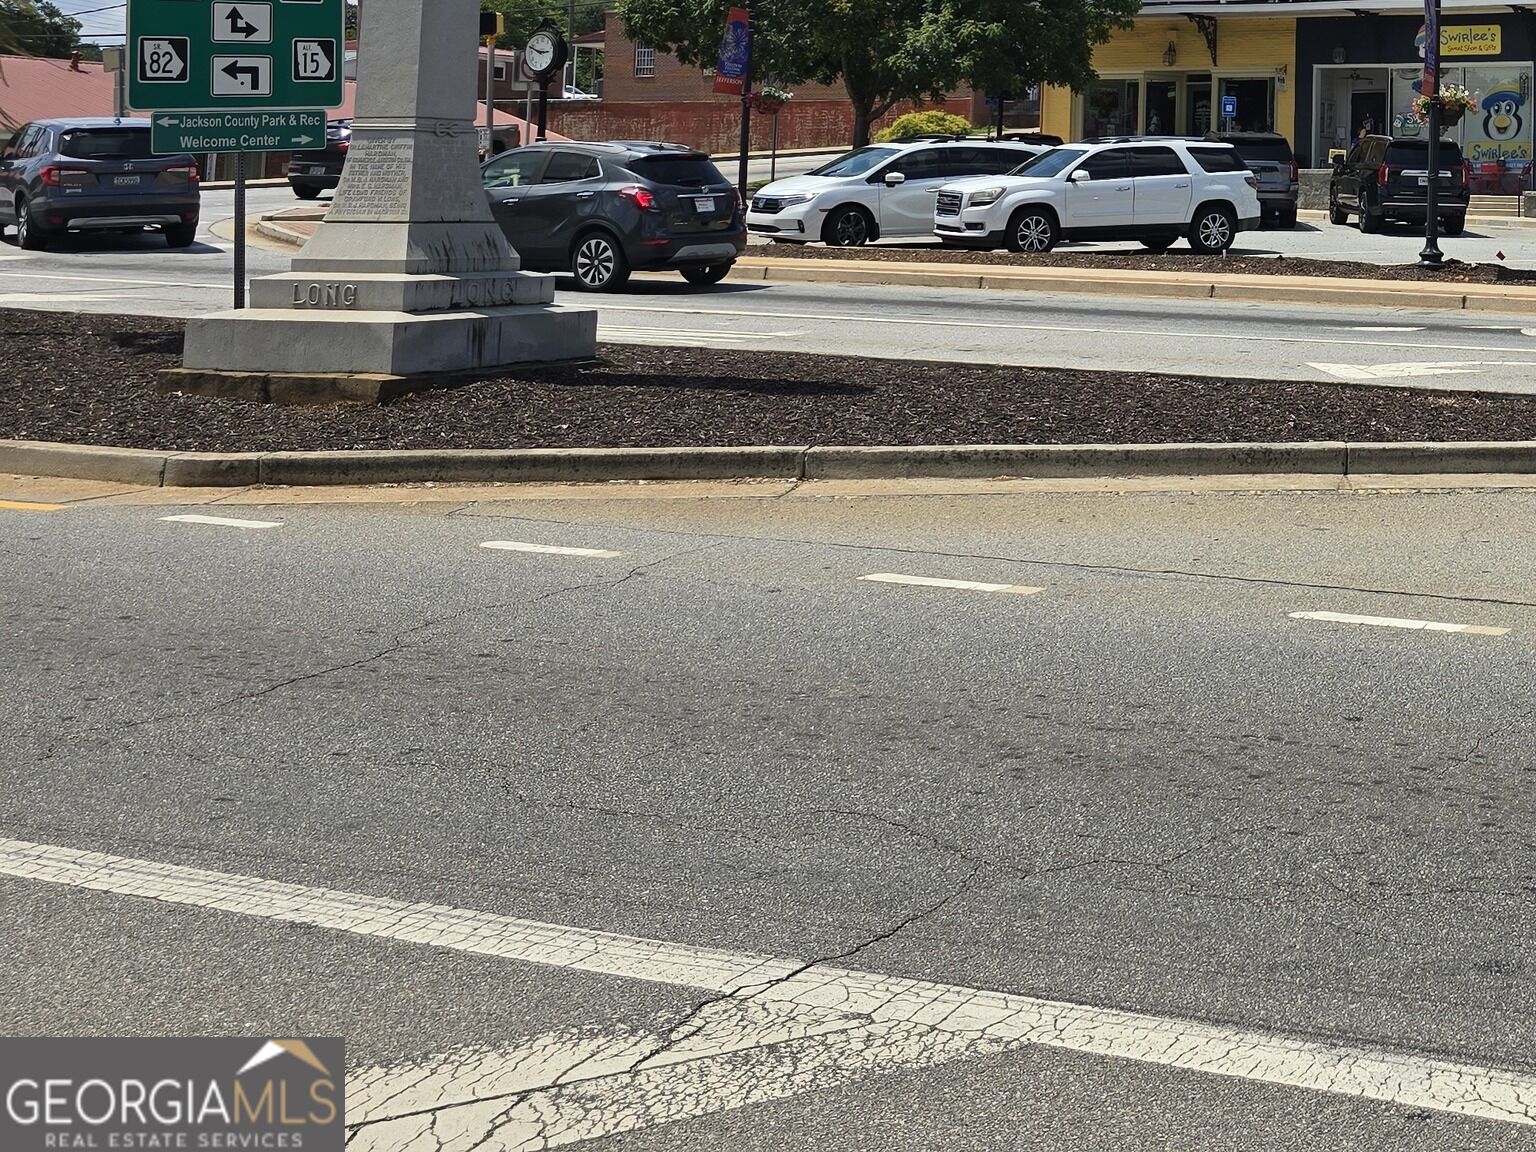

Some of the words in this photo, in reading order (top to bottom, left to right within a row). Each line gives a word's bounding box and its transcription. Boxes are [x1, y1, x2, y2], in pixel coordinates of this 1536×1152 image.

[149, 51, 173, 74] 82
[302, 52, 319, 74] 15
[180, 116, 222, 128] Jackson
[224, 115, 260, 129] County
[262, 115, 286, 126] Park
[289, 115, 297, 126] &
[300, 114, 320, 126] Rec
[180, 135, 236, 148] Welcome
[240, 134, 280, 147] Center
[292, 283, 357, 306] LONG
[451, 281, 515, 306] LONG
